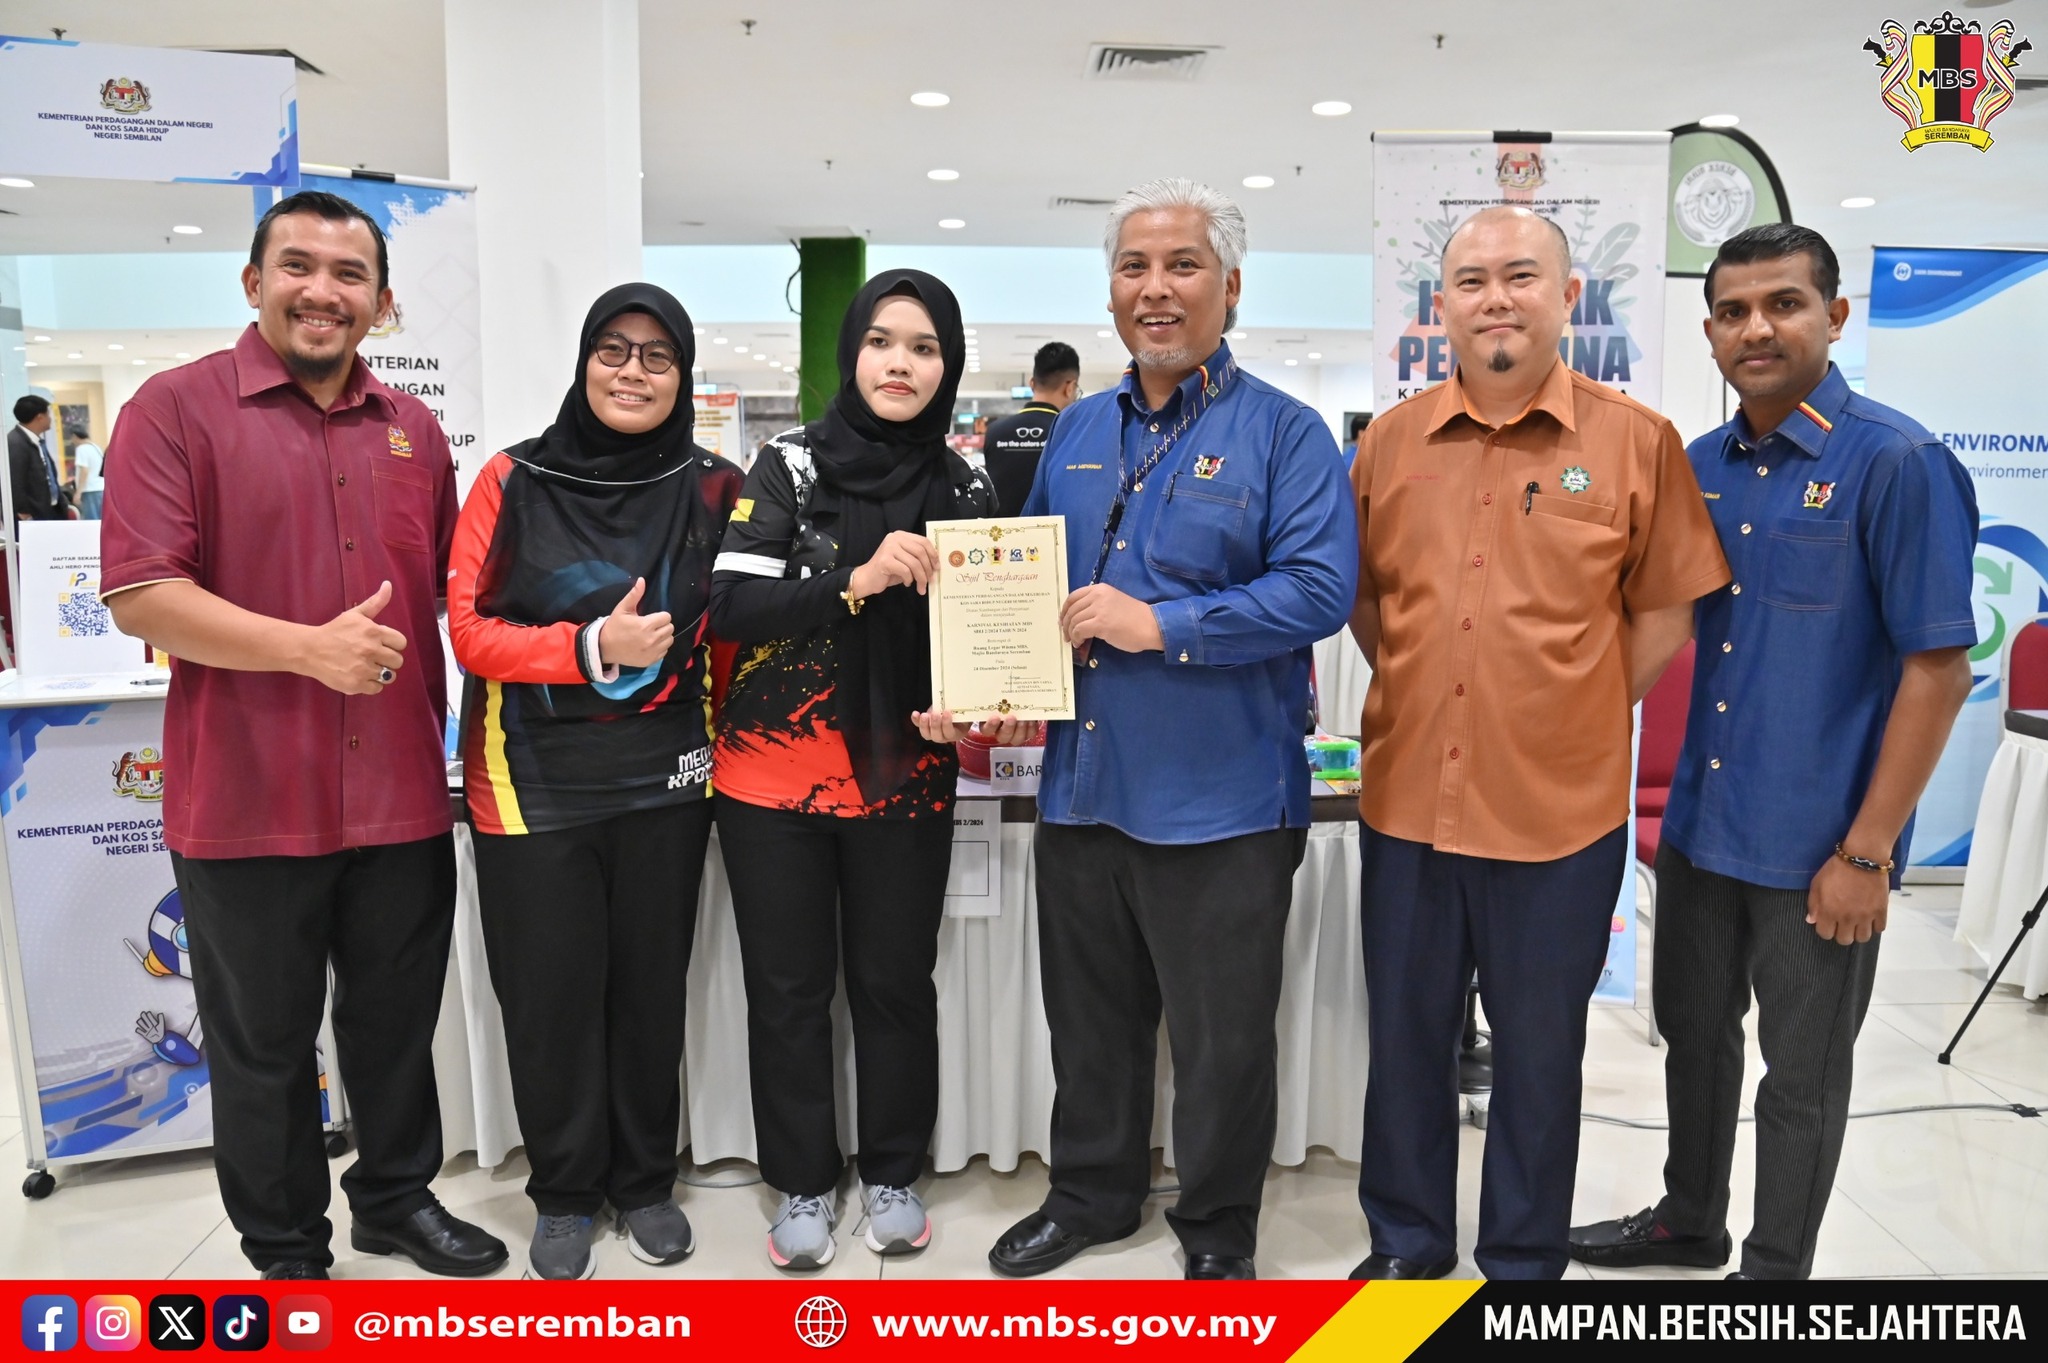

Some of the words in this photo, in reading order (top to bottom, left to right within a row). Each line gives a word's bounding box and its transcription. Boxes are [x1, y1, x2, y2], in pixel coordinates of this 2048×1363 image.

[38, 113, 93, 122] KEMENTERIAN
[96, 116, 156, 126] PERDAGANGAN
[157, 120, 184, 128] DALAM
[186, 121, 213, 129] NEGERI
[124, 134, 162, 142] SEMBILAN
[361, 356, 439, 370] NTERIAN
[1942, 432, 2048, 452] ENVIRONM
[1968, 462, 2048, 478] nvironmen
[983, 572, 1039, 584] Penghargaan
[1016, 765, 1042, 777] BAR
[17, 822, 104, 839] KEMENTERIAN
[107, 818, 164, 832] PERDAGA
[92, 834, 120, 845] DAN
[122, 832, 148, 843] KOS
[106, 844, 150, 856] NEGERI
